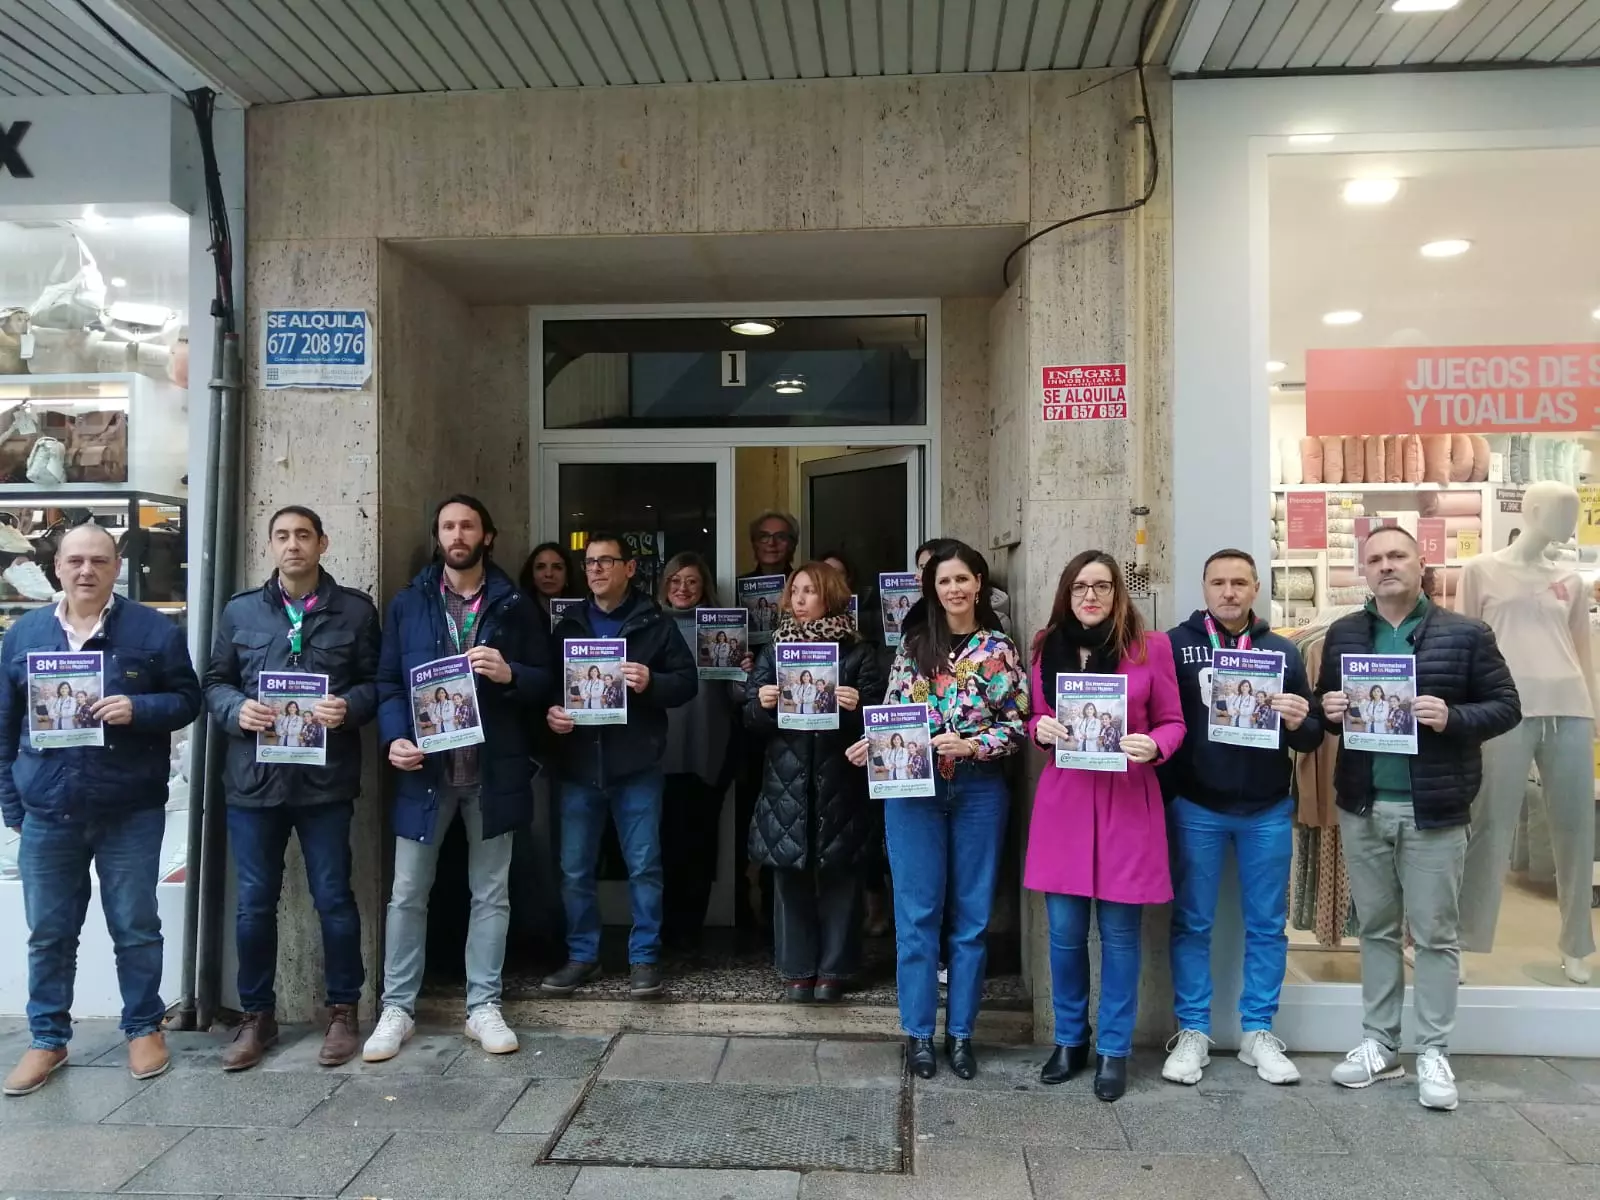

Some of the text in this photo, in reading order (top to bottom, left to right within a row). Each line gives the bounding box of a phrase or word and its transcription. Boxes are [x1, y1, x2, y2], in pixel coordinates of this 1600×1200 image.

[268, 314, 364, 330] SE ALQUILA
[268, 332, 364, 354] 677 208 976
[728, 353, 740, 383] 1
[1406, 356, 1530, 390] JUEGOS
[1538, 355, 1582, 388] DE
[1044, 388, 1126, 404] SE ALQUILA
[1046, 404, 1124, 420] 671 657 652
[1406, 394, 1429, 426] Y
[1434, 391, 1578, 426] TOALLAS
[1421, 538, 1438, 552] 15
[884, 578, 899, 587] 8M
[702, 614, 716, 622] 8M
[571, 646, 588, 655] 8M
[782, 649, 800, 659] 8M
[36, 660, 57, 670] 8M
[1220, 656, 1240, 667] 8M
[1349, 662, 1369, 673] 8M
[416, 670, 432, 682] 8M
[266, 679, 286, 689] 8M
[1064, 680, 1083, 691] 8M
[871, 712, 889, 723] 8M
